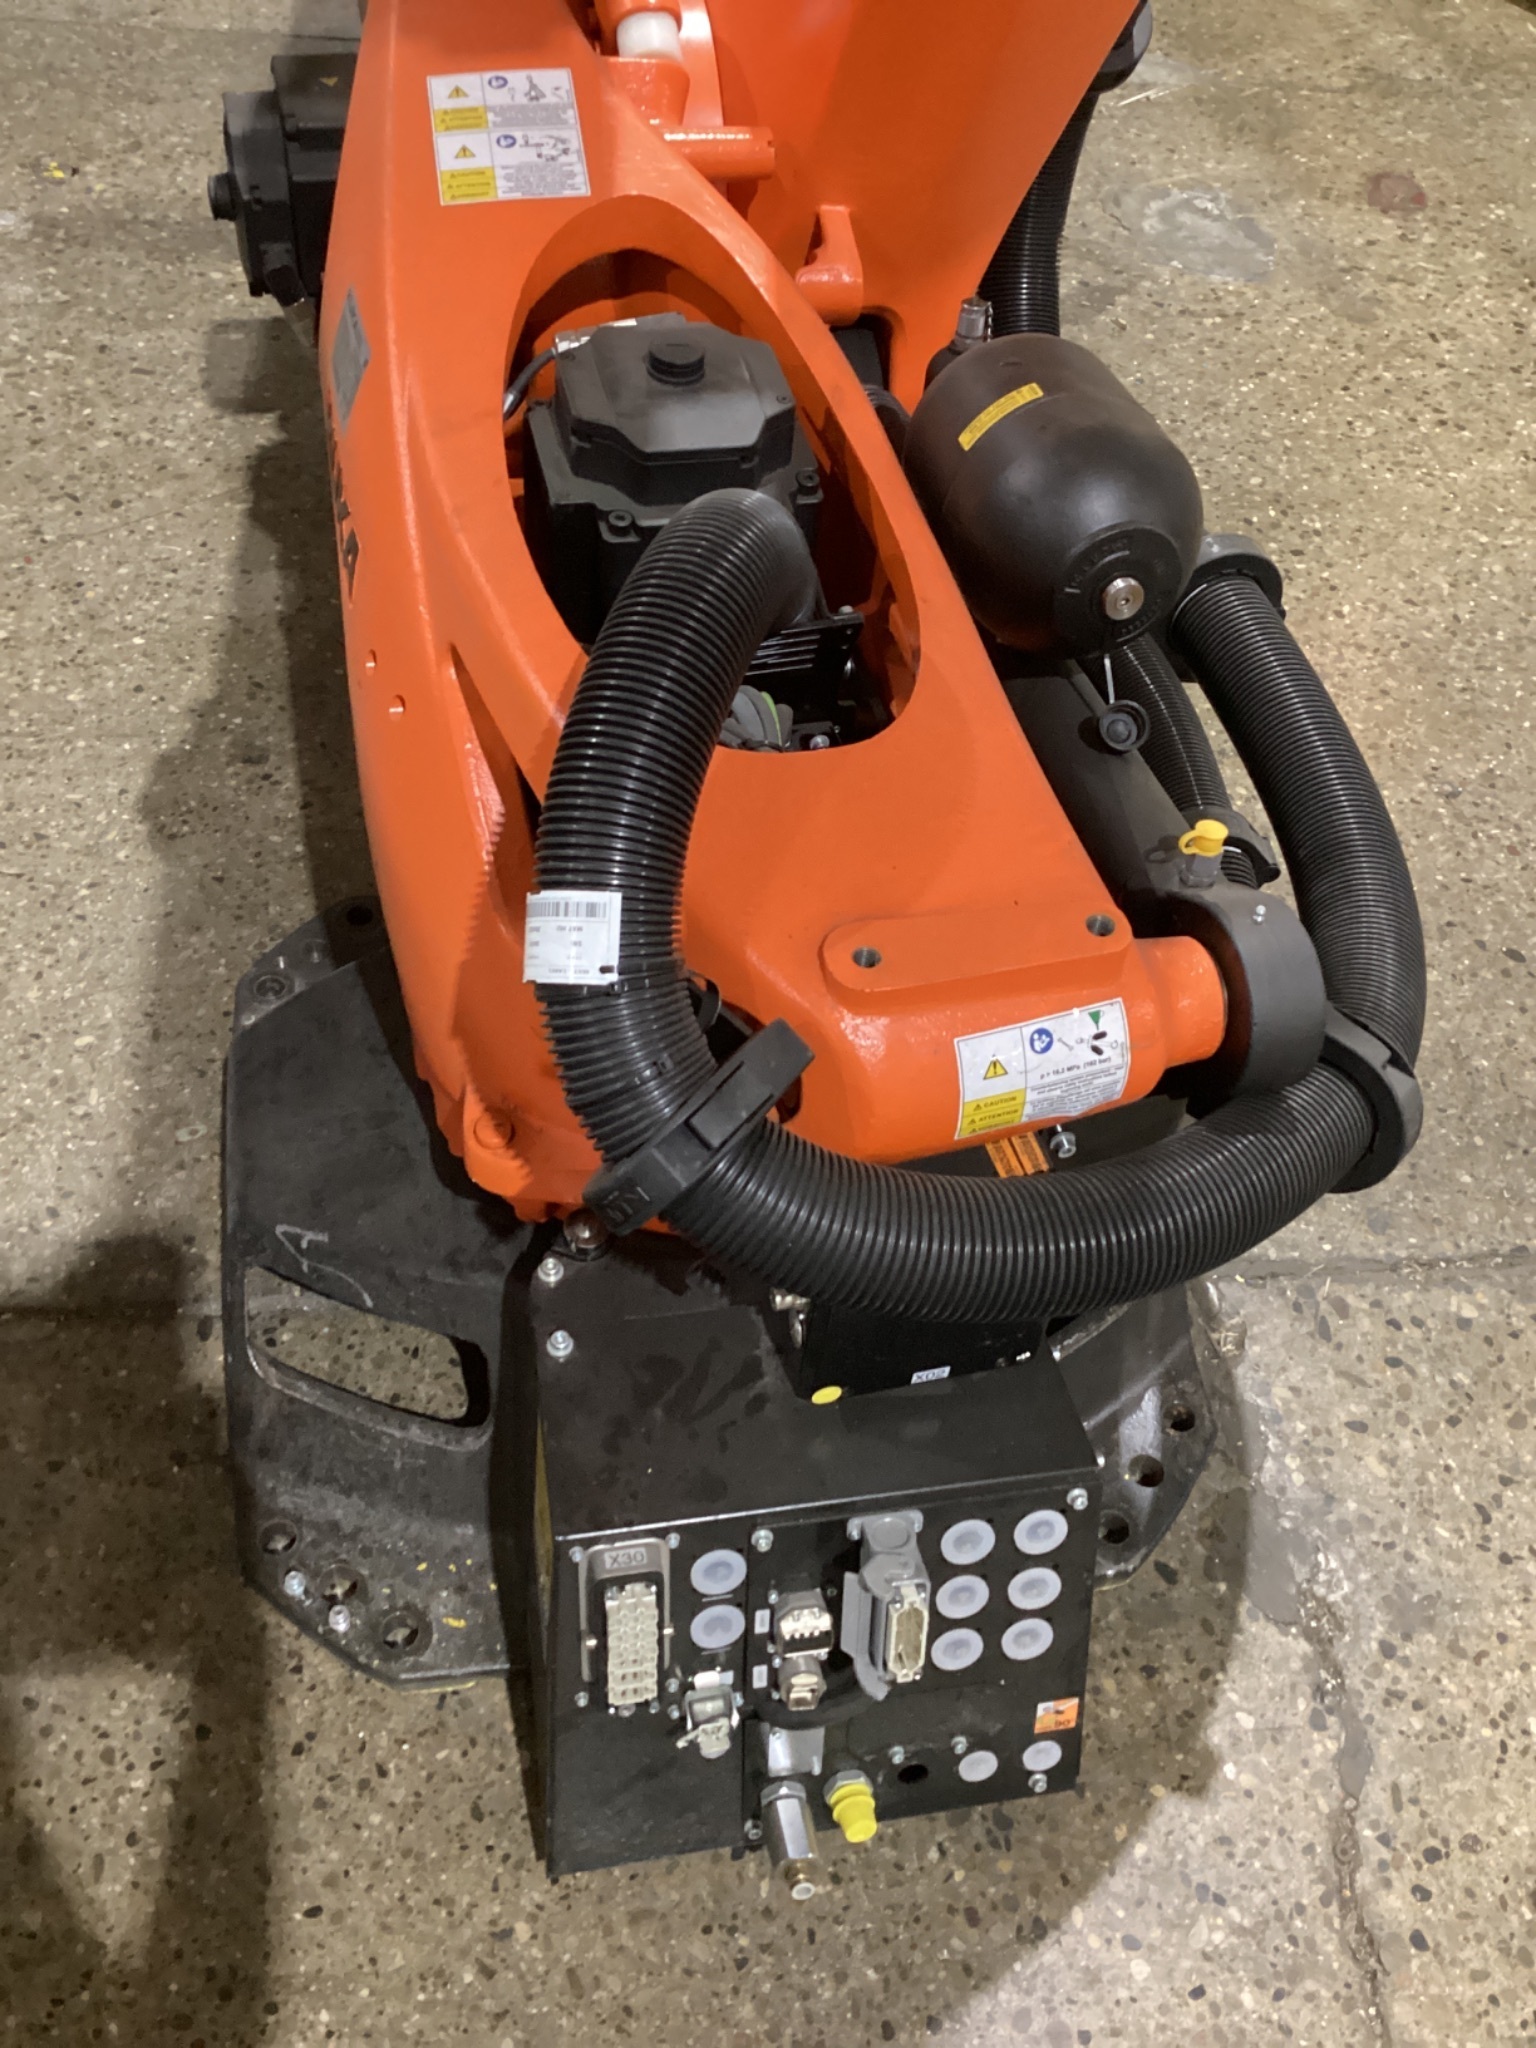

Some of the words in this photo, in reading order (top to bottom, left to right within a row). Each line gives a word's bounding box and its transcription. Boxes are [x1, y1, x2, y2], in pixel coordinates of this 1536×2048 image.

[983, 1095, 1017, 1108] CAUTION
[978, 1109, 1019, 1122] ATTENTION
[608, 1550, 645, 1568] X30
